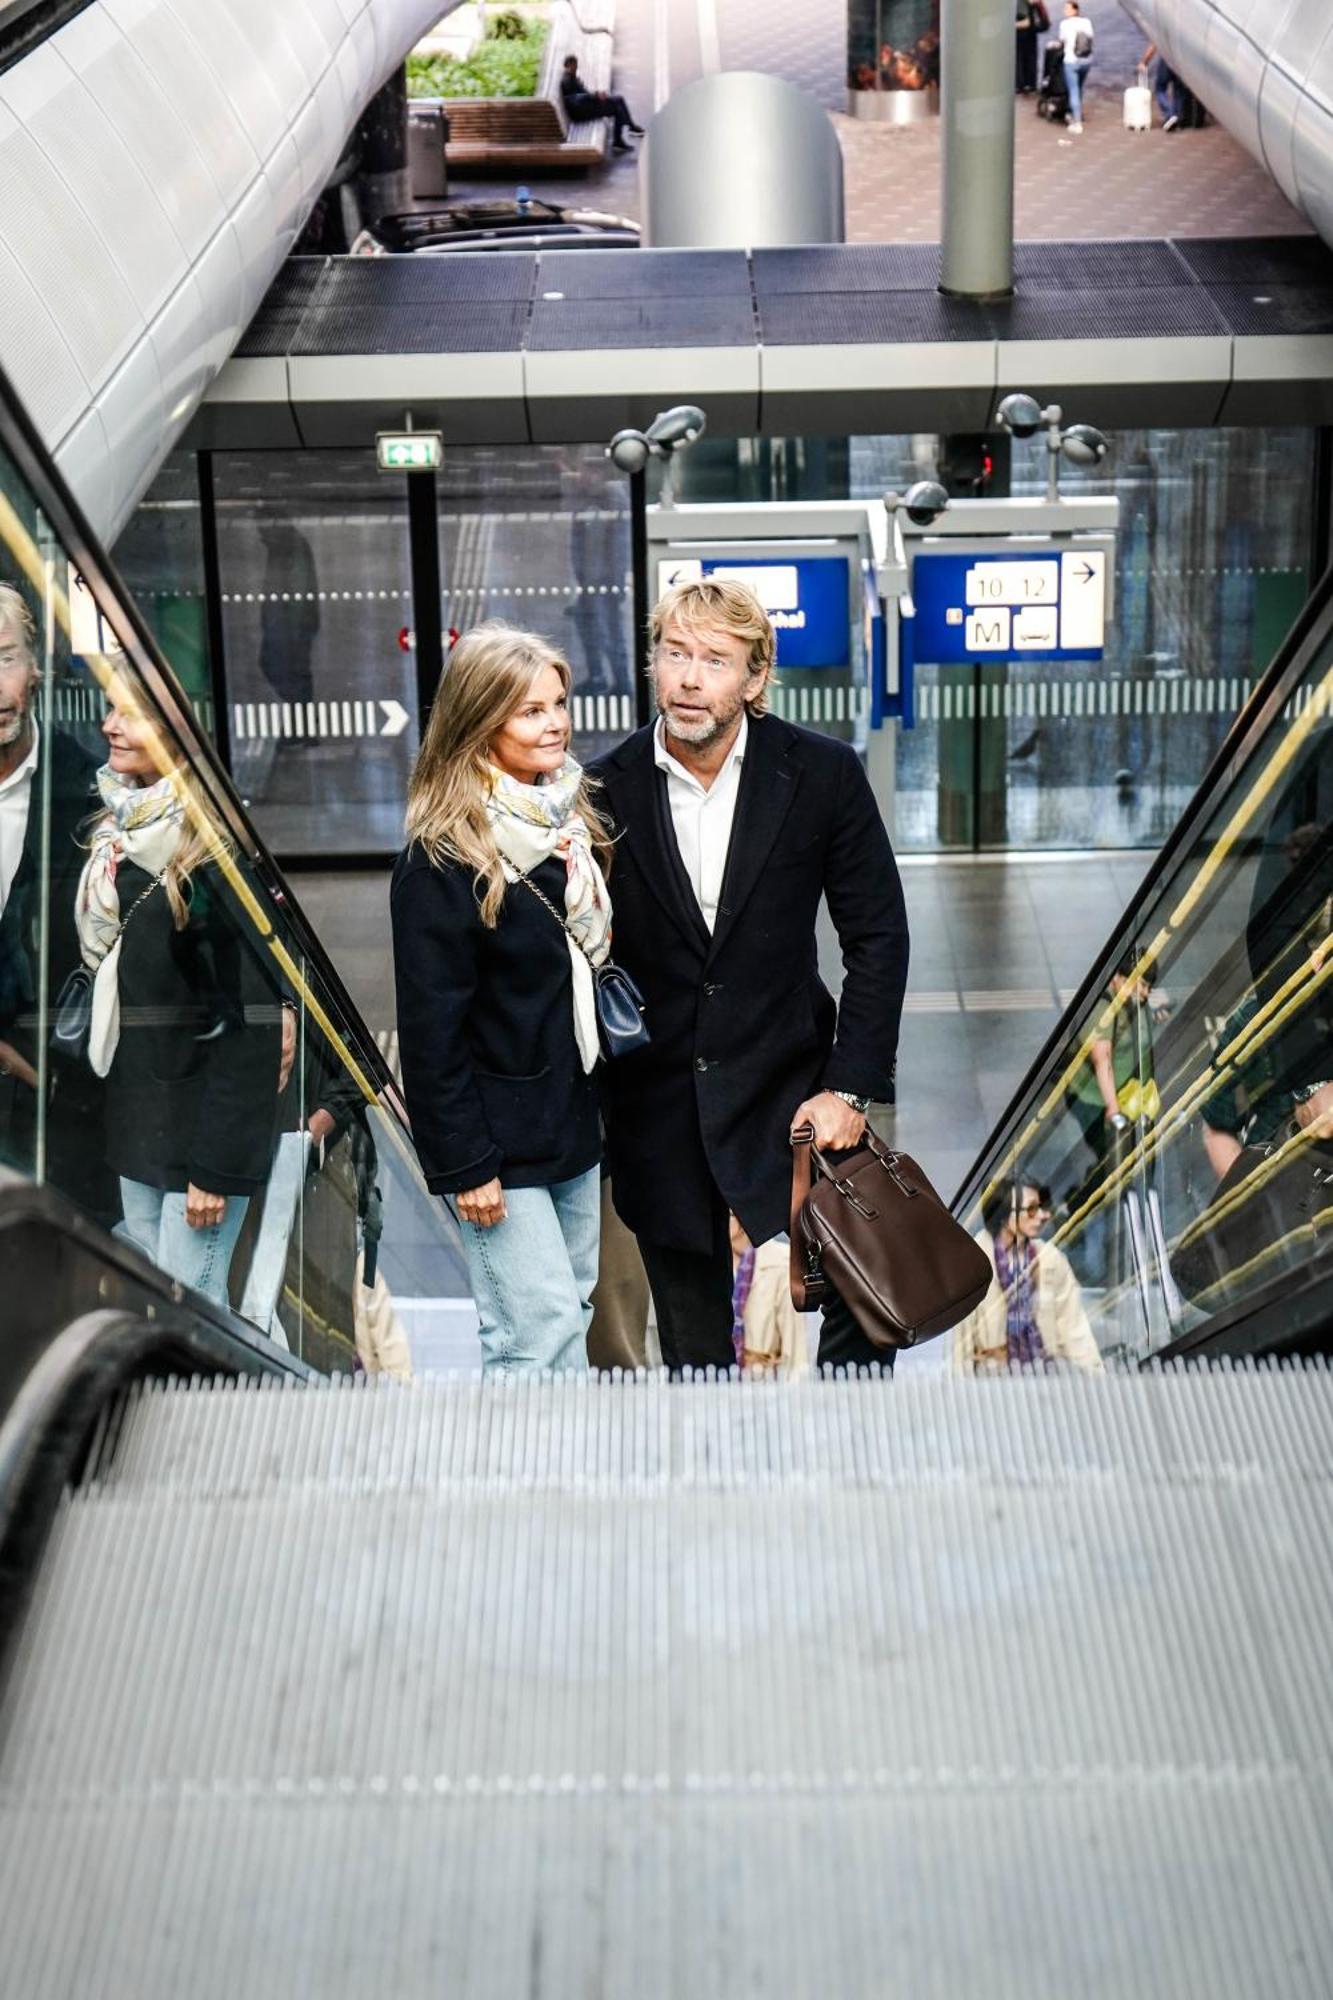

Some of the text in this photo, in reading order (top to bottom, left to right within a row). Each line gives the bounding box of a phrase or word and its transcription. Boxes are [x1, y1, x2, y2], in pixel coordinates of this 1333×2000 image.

[978, 577, 1046, 598] 10 12
[975, 622, 1001, 644] M
